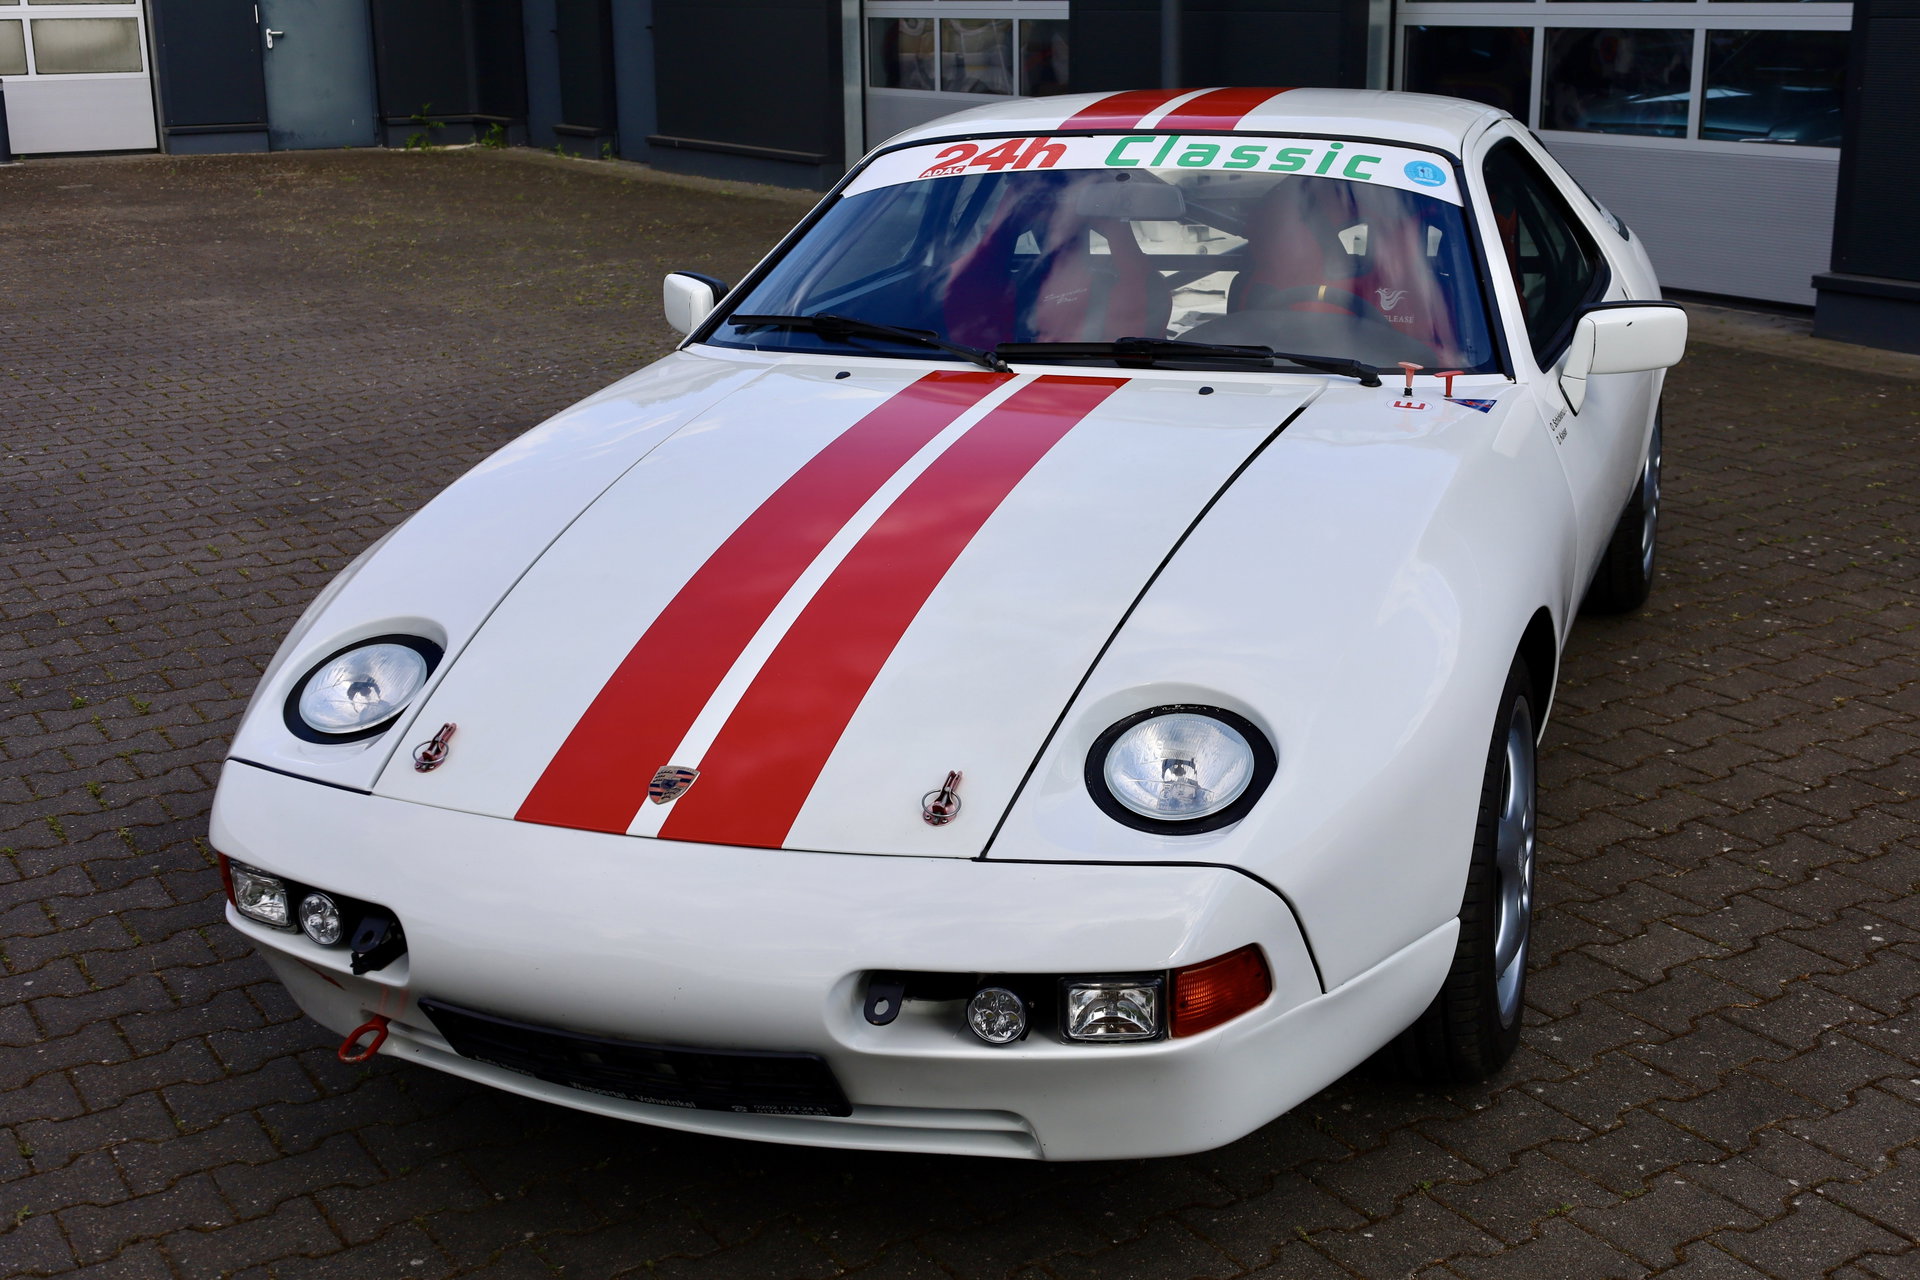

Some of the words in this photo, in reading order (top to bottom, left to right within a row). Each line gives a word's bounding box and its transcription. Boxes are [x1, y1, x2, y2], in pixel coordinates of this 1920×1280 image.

[918, 137, 1068, 178] 24h
[1104, 135, 1382, 180] Classic
[922, 165, 962, 177] ADAC
